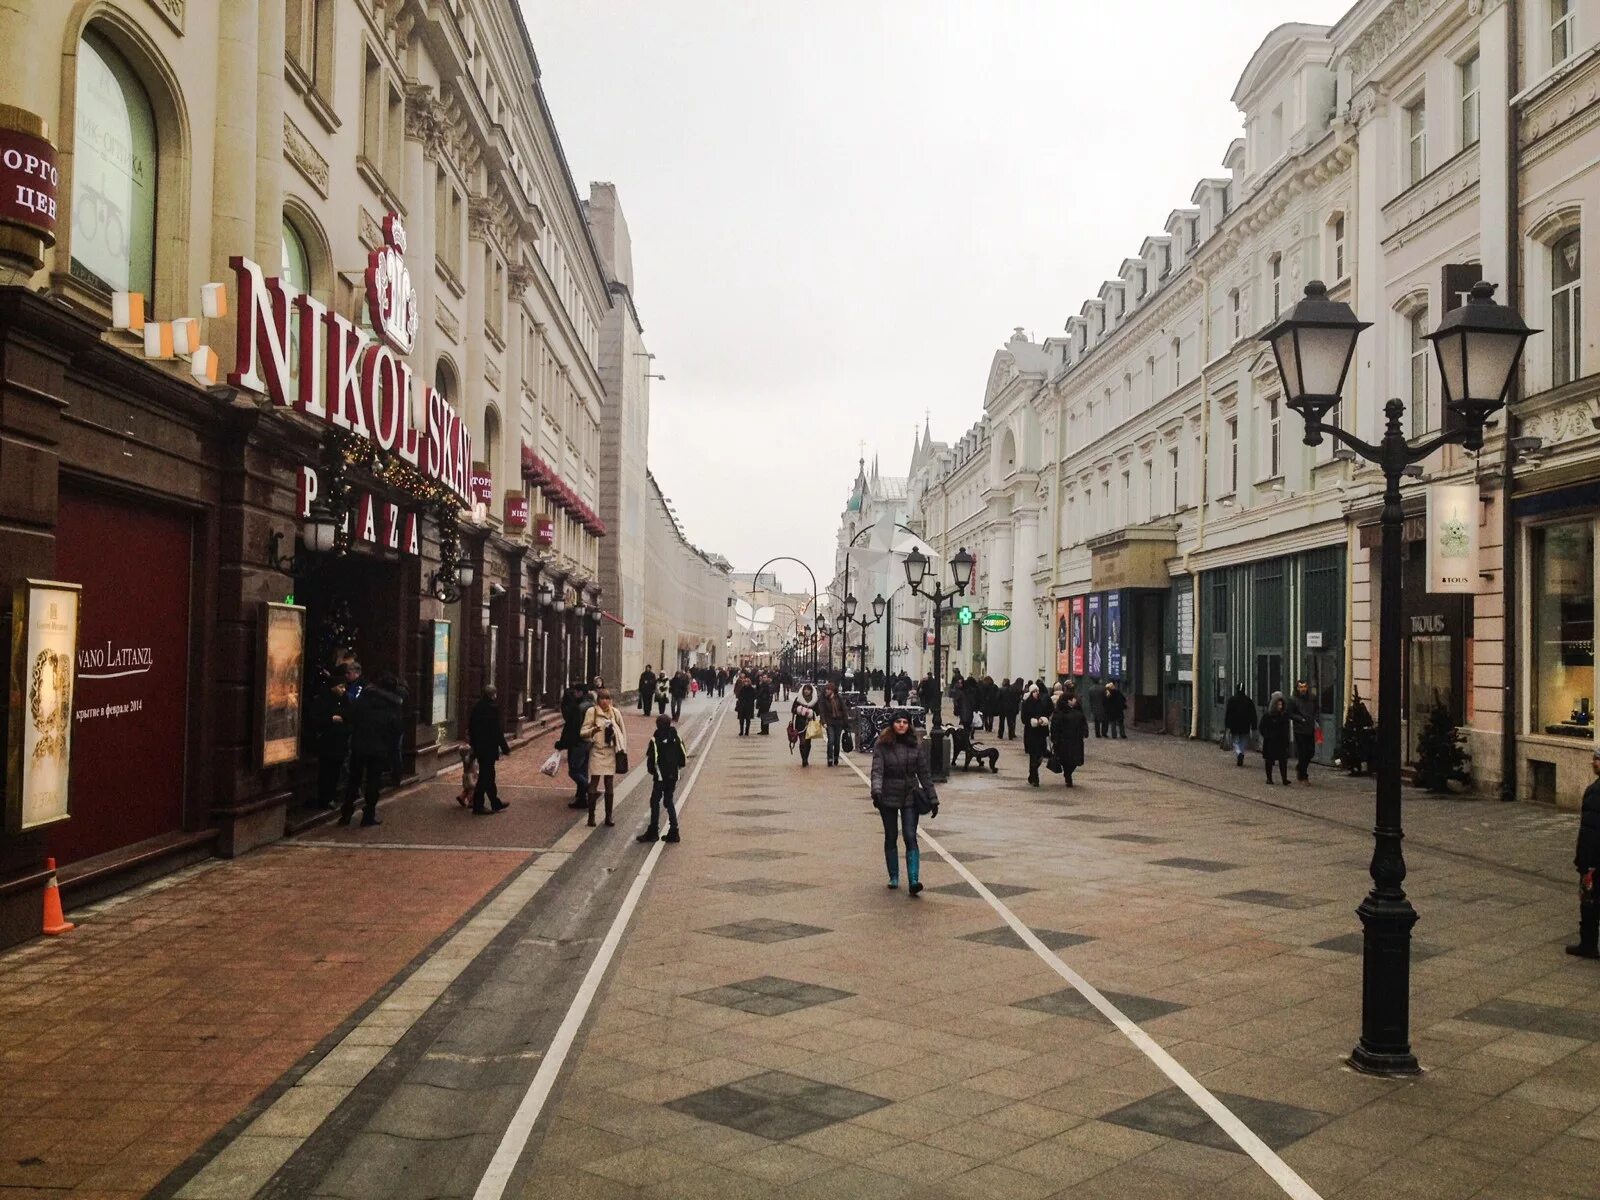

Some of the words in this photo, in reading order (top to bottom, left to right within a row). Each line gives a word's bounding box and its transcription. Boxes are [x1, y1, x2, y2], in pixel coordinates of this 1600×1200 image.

[2, 149, 57, 187] ОРГО
[301, 465, 419, 556] PAZA
[982, 618, 1009, 627] SUBWAY
[1410, 614, 1445, 633] TOUS
[100, 707, 105, 717] в
[105, 703, 129, 719] феврале
[130, 699, 143, 712] 2014
